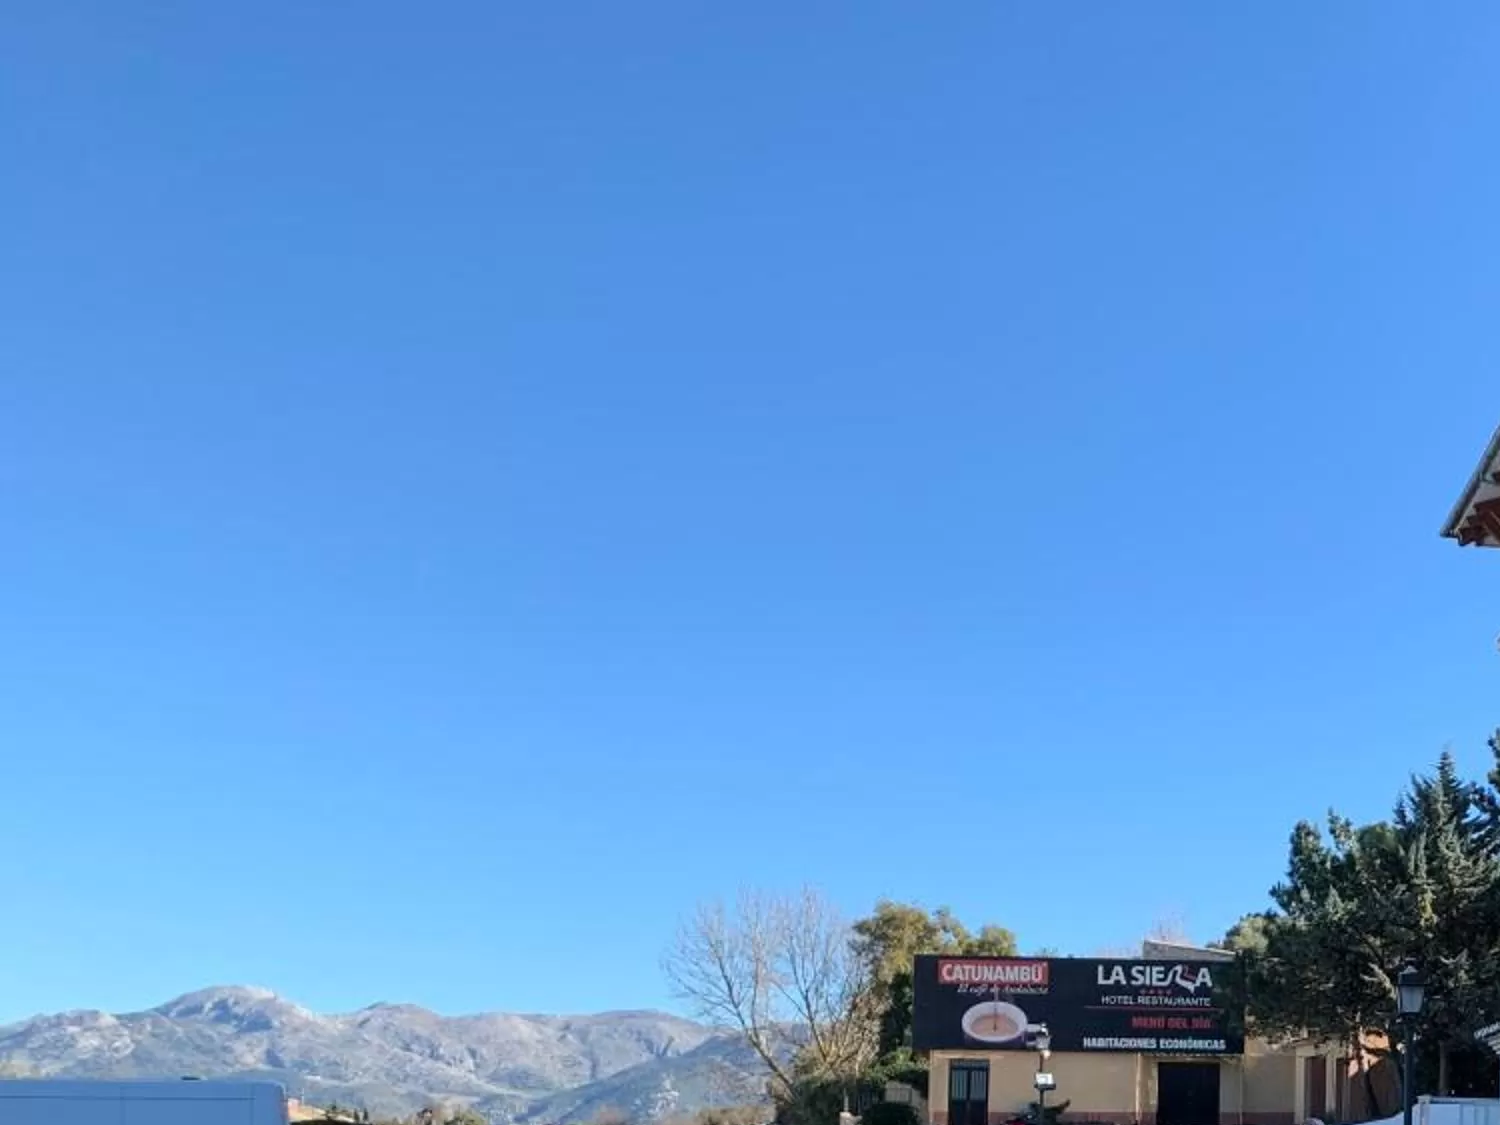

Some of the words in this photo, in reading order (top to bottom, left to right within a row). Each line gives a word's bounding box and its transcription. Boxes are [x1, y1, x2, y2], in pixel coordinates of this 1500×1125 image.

[1097, 964, 1127, 986] LA
[1101, 994, 1134, 1005] HOTEL
[1137, 995, 1212, 1007] RESTAURANTE
[1083, 1036, 1157, 1049] HABITACIONES
[1159, 1036, 1227, 1050] ECONÓMICAS
